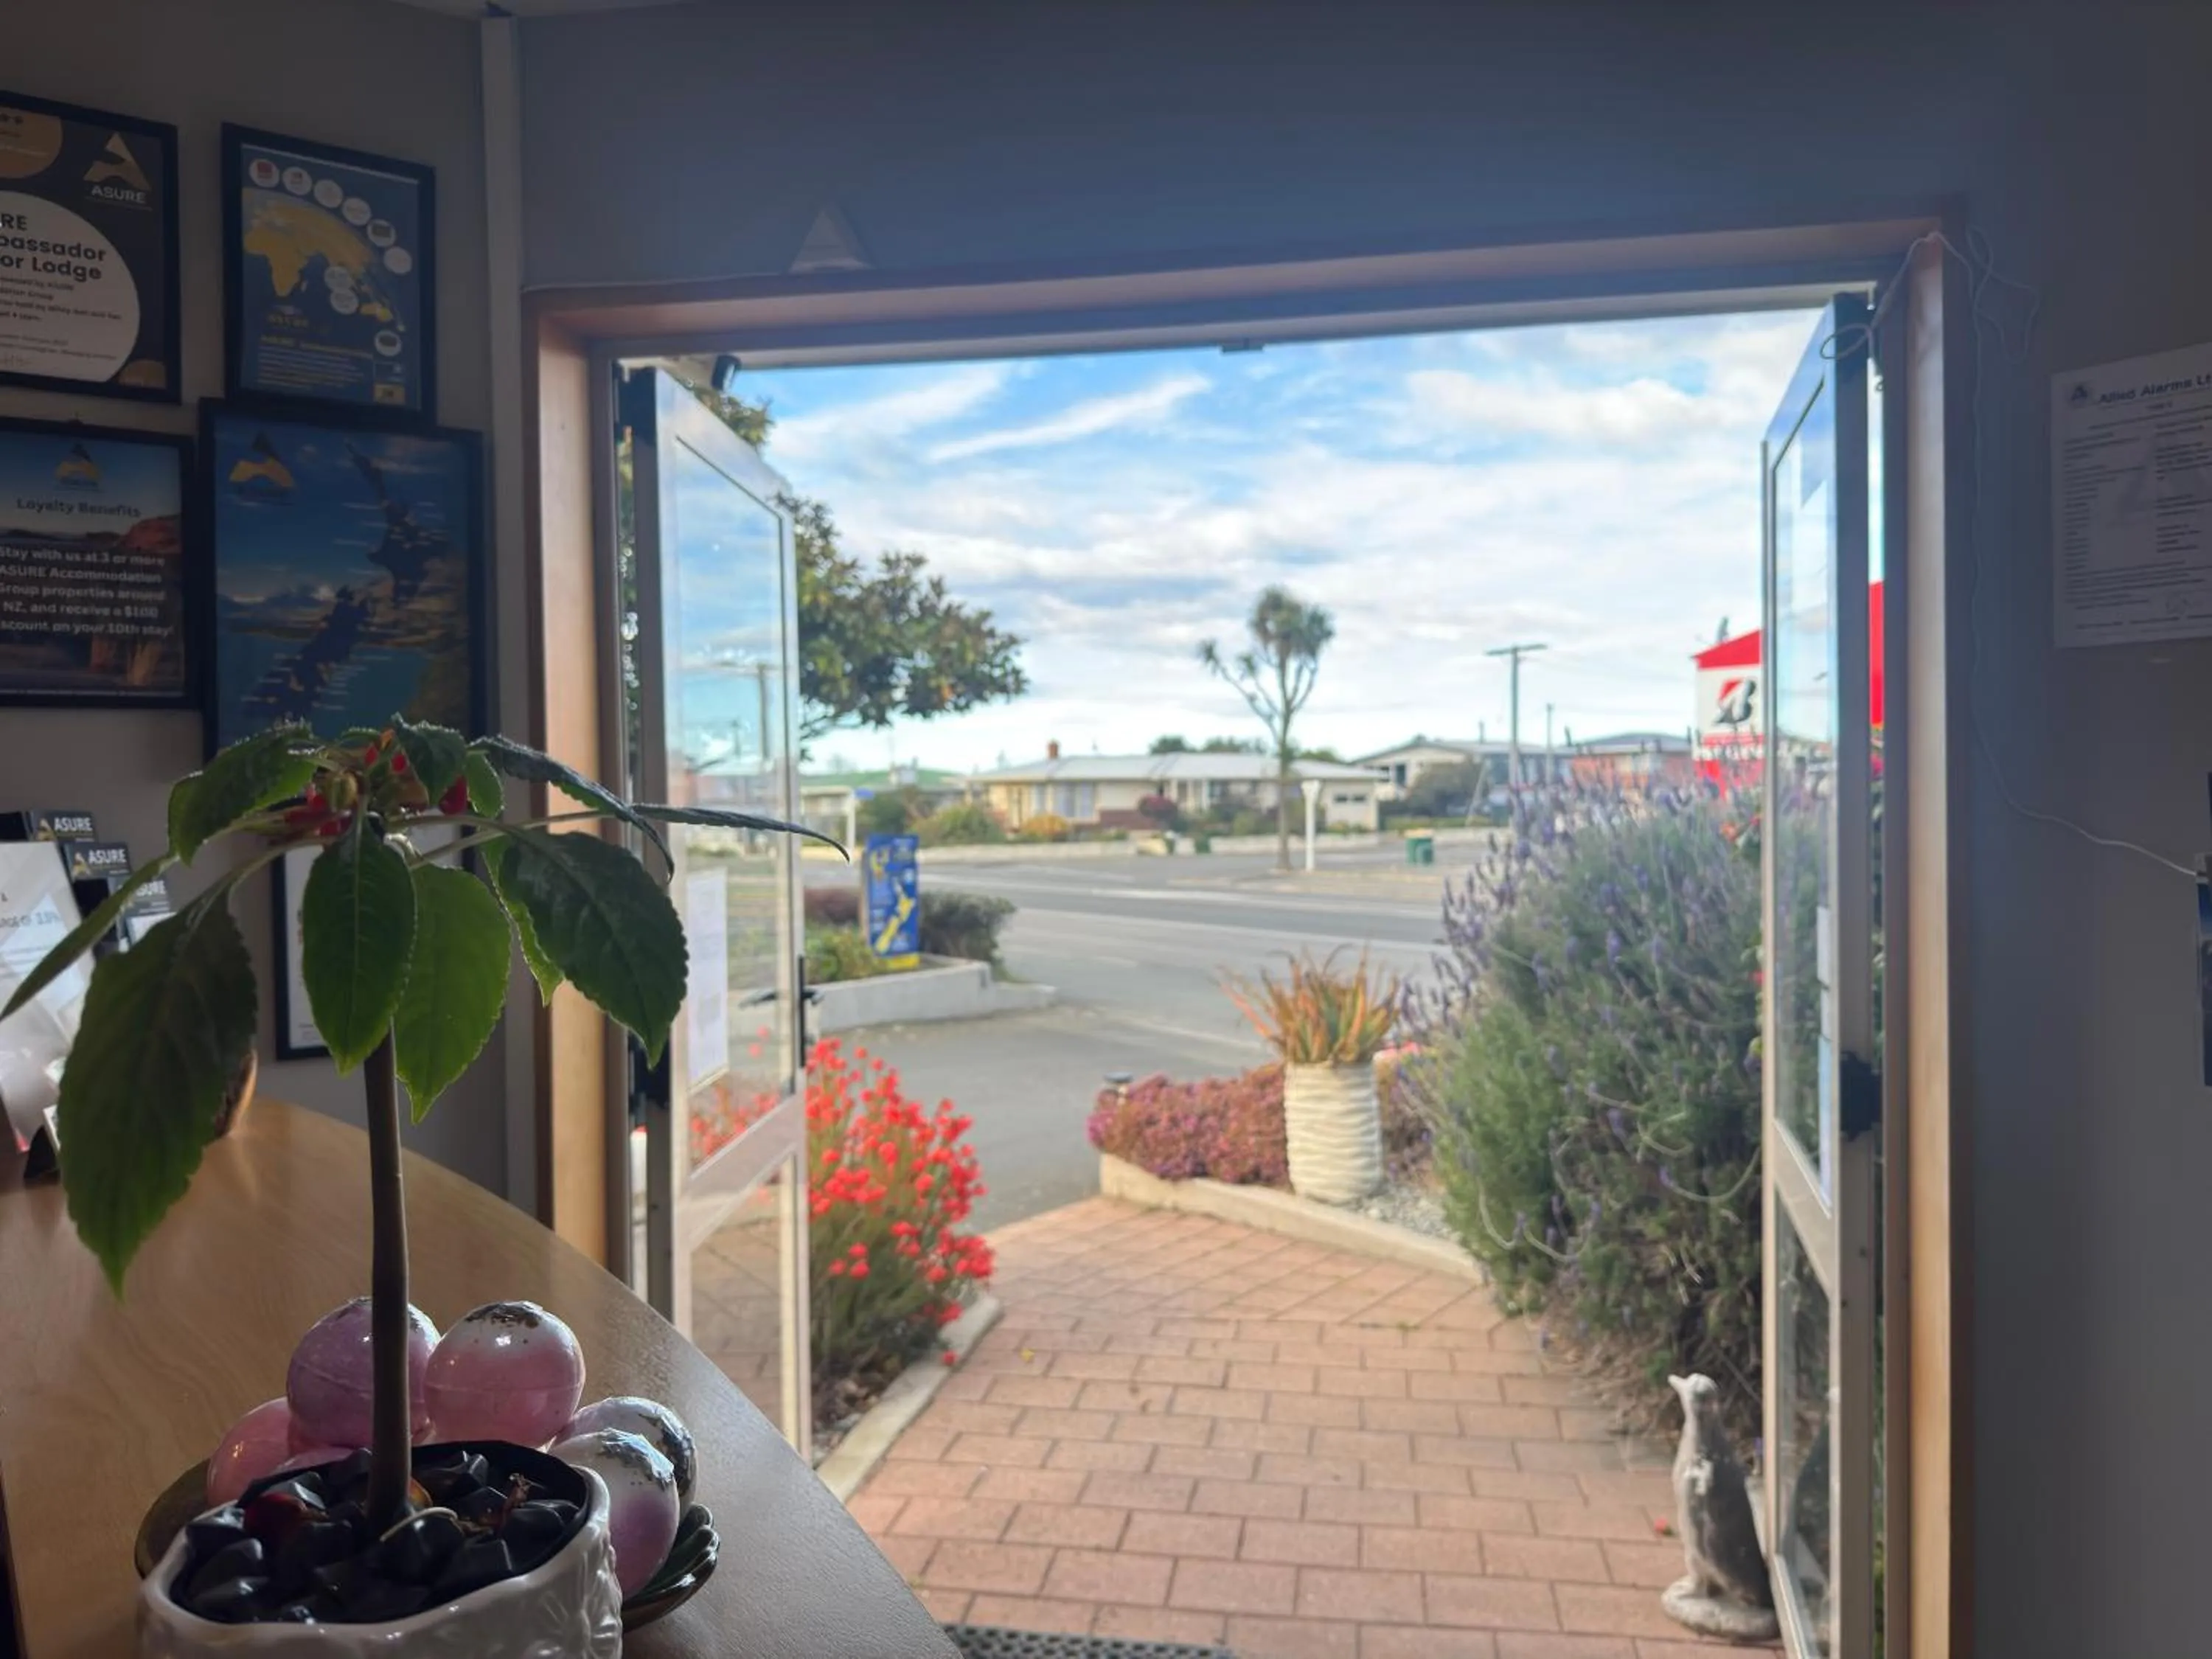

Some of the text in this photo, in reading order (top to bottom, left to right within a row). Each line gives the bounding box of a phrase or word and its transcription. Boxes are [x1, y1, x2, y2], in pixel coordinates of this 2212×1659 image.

[91, 185, 147, 204] ASURE
[32, 256, 102, 283] Lodge
[2100, 389, 2136, 403] Allied
[2140, 378, 2192, 397] Alarms
[16, 497, 142, 518] Loyalty Benefits
[31, 549, 62, 561] with
[0, 564, 161, 582] ASURE Accommodation
[42, 586, 114, 599] properties
[30, 603, 57, 613] and
[60, 604, 111, 616] receive
[74, 623, 104, 635] your
[54, 816, 93, 832] ASURE
[88, 849, 127, 865] ASURE
[136, 880, 167, 897] SURE
